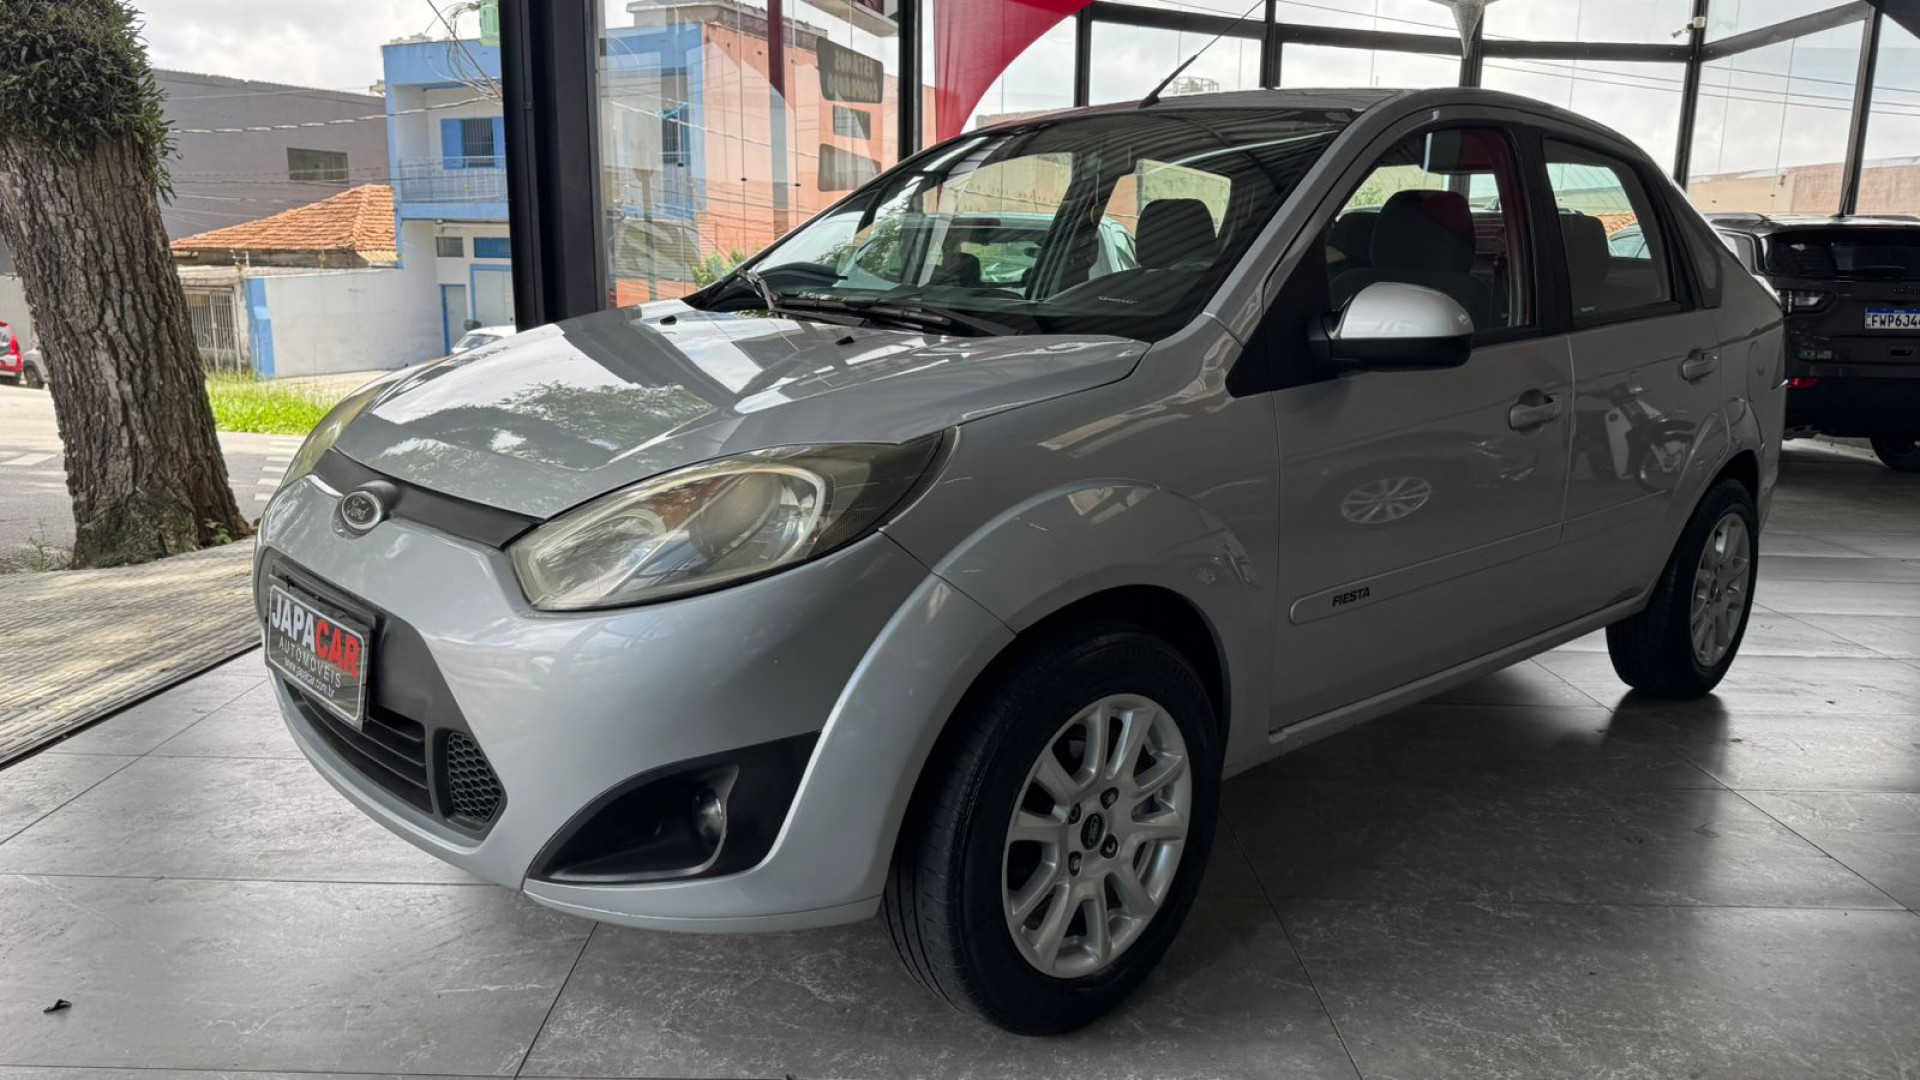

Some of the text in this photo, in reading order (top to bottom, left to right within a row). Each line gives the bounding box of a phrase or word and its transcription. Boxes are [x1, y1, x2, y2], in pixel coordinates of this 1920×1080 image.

[1871, 314, 1920, 327] FWP6J4
[1332, 587, 1371, 607] FIESTA
[271, 593, 361, 680] JAPACAR
